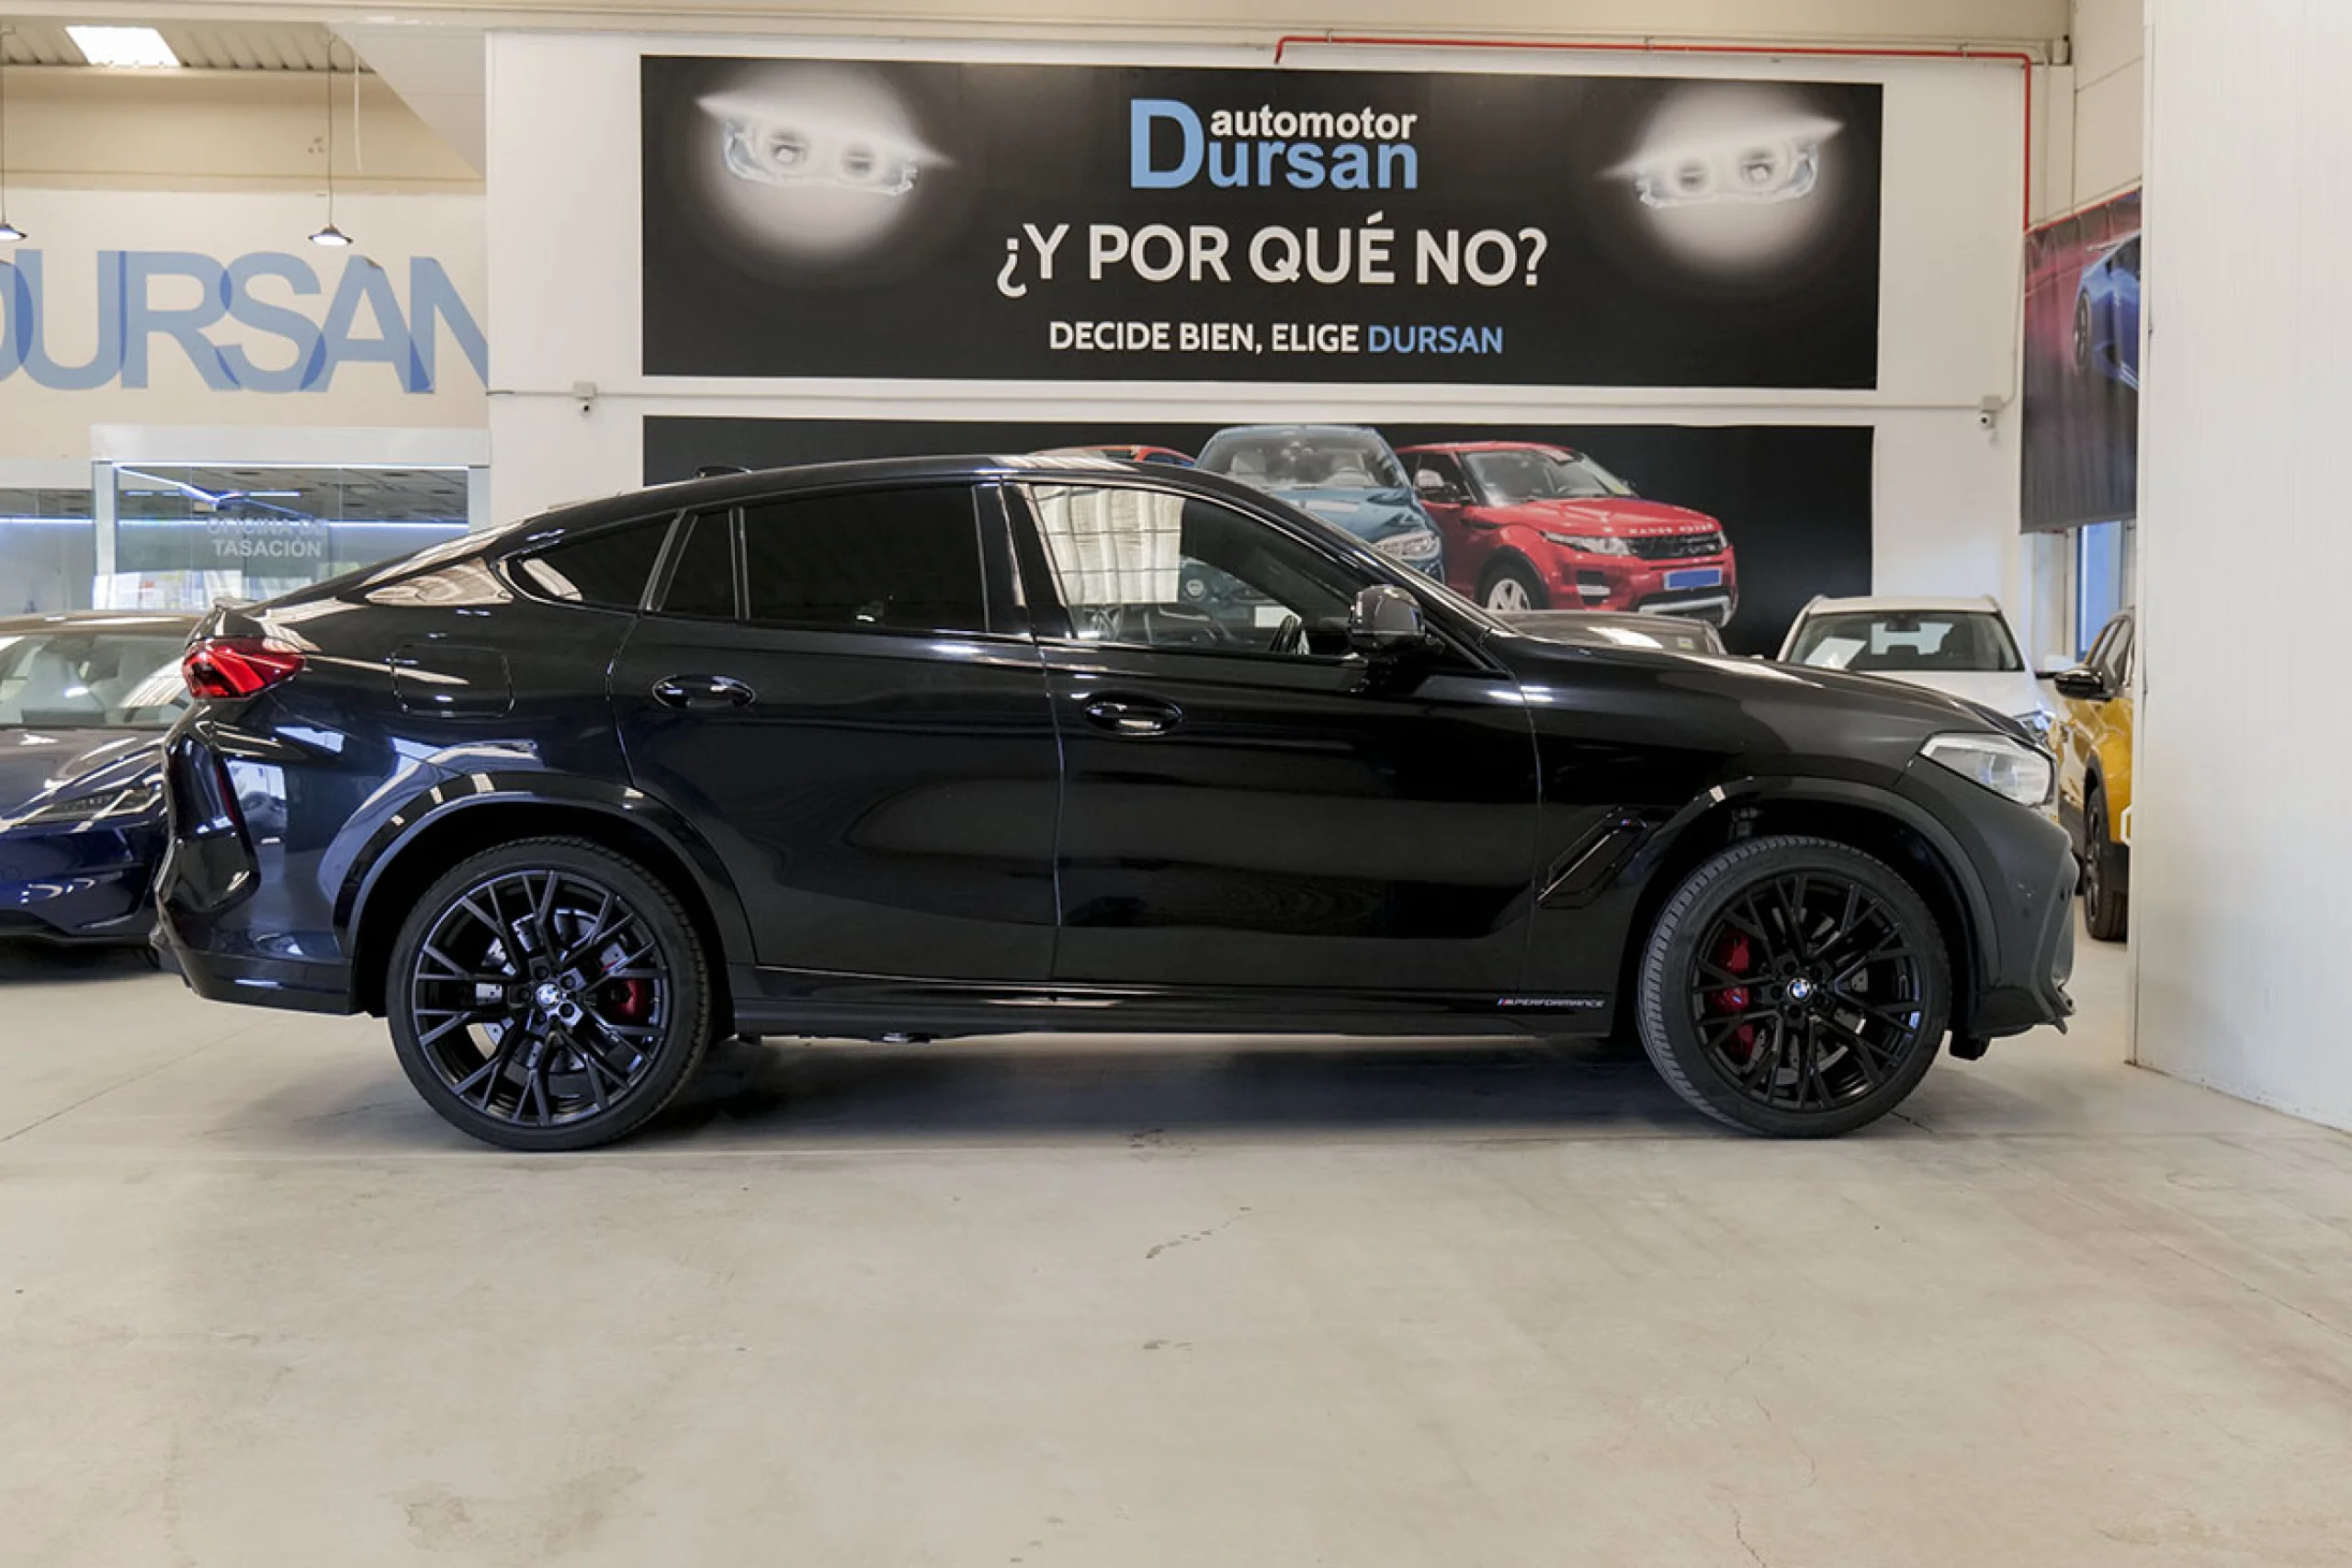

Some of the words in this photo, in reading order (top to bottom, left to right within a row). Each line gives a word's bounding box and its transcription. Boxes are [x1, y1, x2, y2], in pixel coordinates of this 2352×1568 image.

[1210, 103, 1418, 140] automotor
[1130, 98, 1418, 189] Dursan
[996, 222, 1070, 299] ¿Y
[1089, 224, 1232, 282] POR
[1248, 210, 1396, 285] QUÉ
[1416, 227, 1548, 288] NO?
[1049, 321, 1171, 351] DECIDE
[1179, 322, 1264, 355] BIEN,
[1272, 322, 1360, 353] ELIGE
[1369, 324, 1503, 354] DURSAN
[211, 536, 322, 558] TASACIÓN
